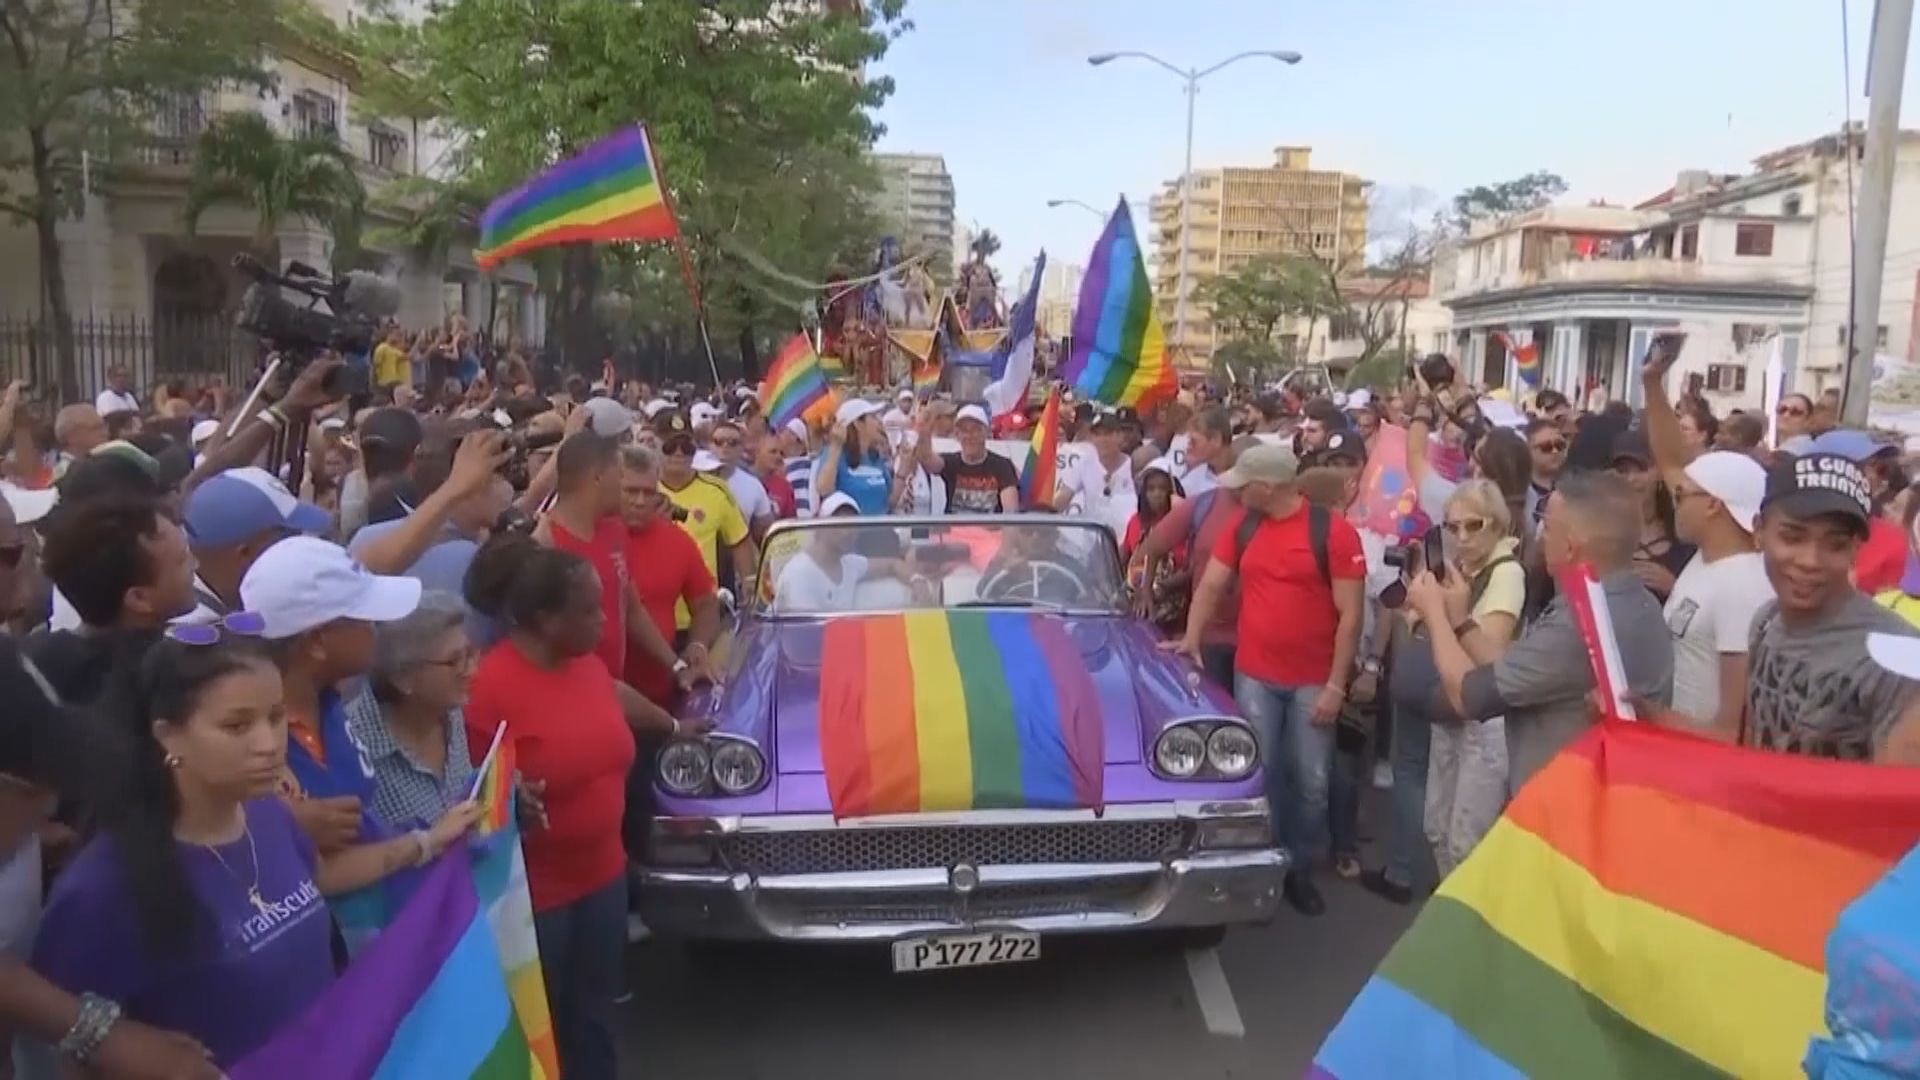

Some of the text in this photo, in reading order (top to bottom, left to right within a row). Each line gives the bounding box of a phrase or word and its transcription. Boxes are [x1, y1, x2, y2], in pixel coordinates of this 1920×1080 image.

[1795, 458, 1815, 474] EL
[914, 937, 1036, 968] P 177 272
